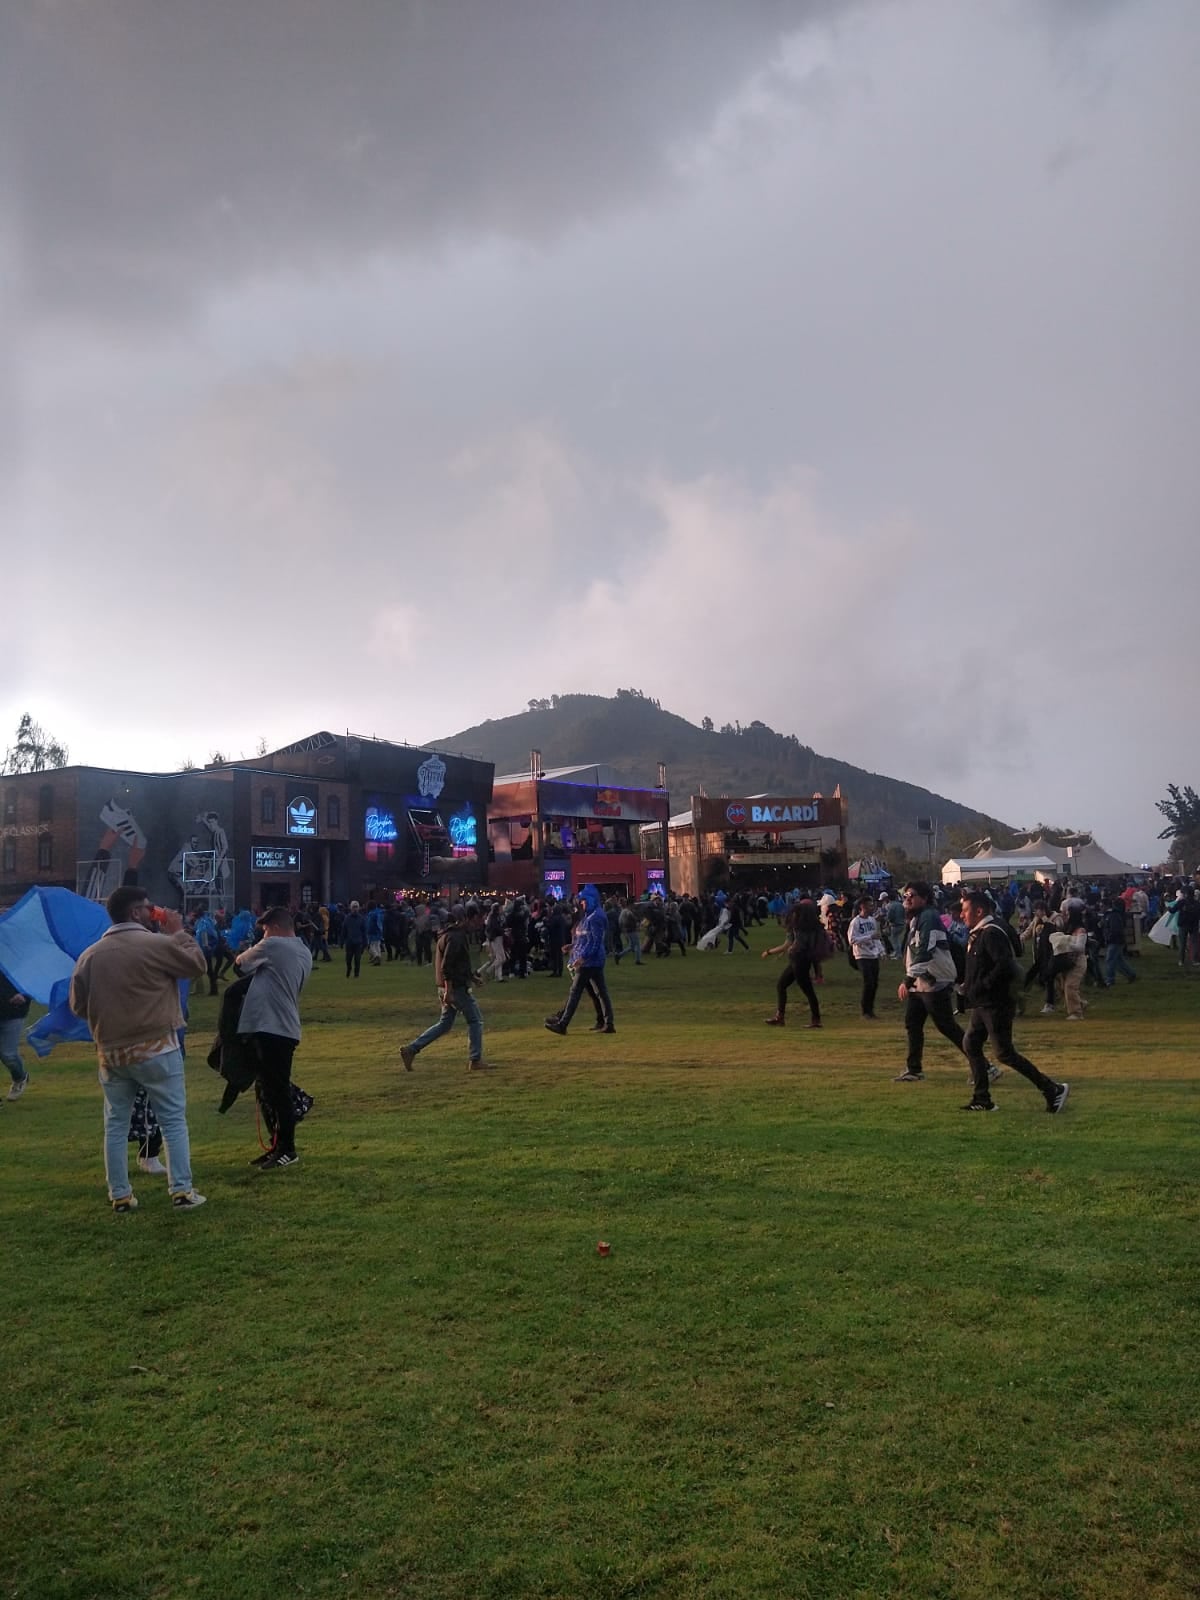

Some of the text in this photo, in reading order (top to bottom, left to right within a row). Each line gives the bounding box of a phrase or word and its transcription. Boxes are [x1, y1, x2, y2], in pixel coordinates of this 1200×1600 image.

[752, 801, 818, 822] BACARDÍ
[290, 825, 315, 834] adidas
[255, 851, 274, 859] HOME
[255, 859, 286, 868] CLASSICS
